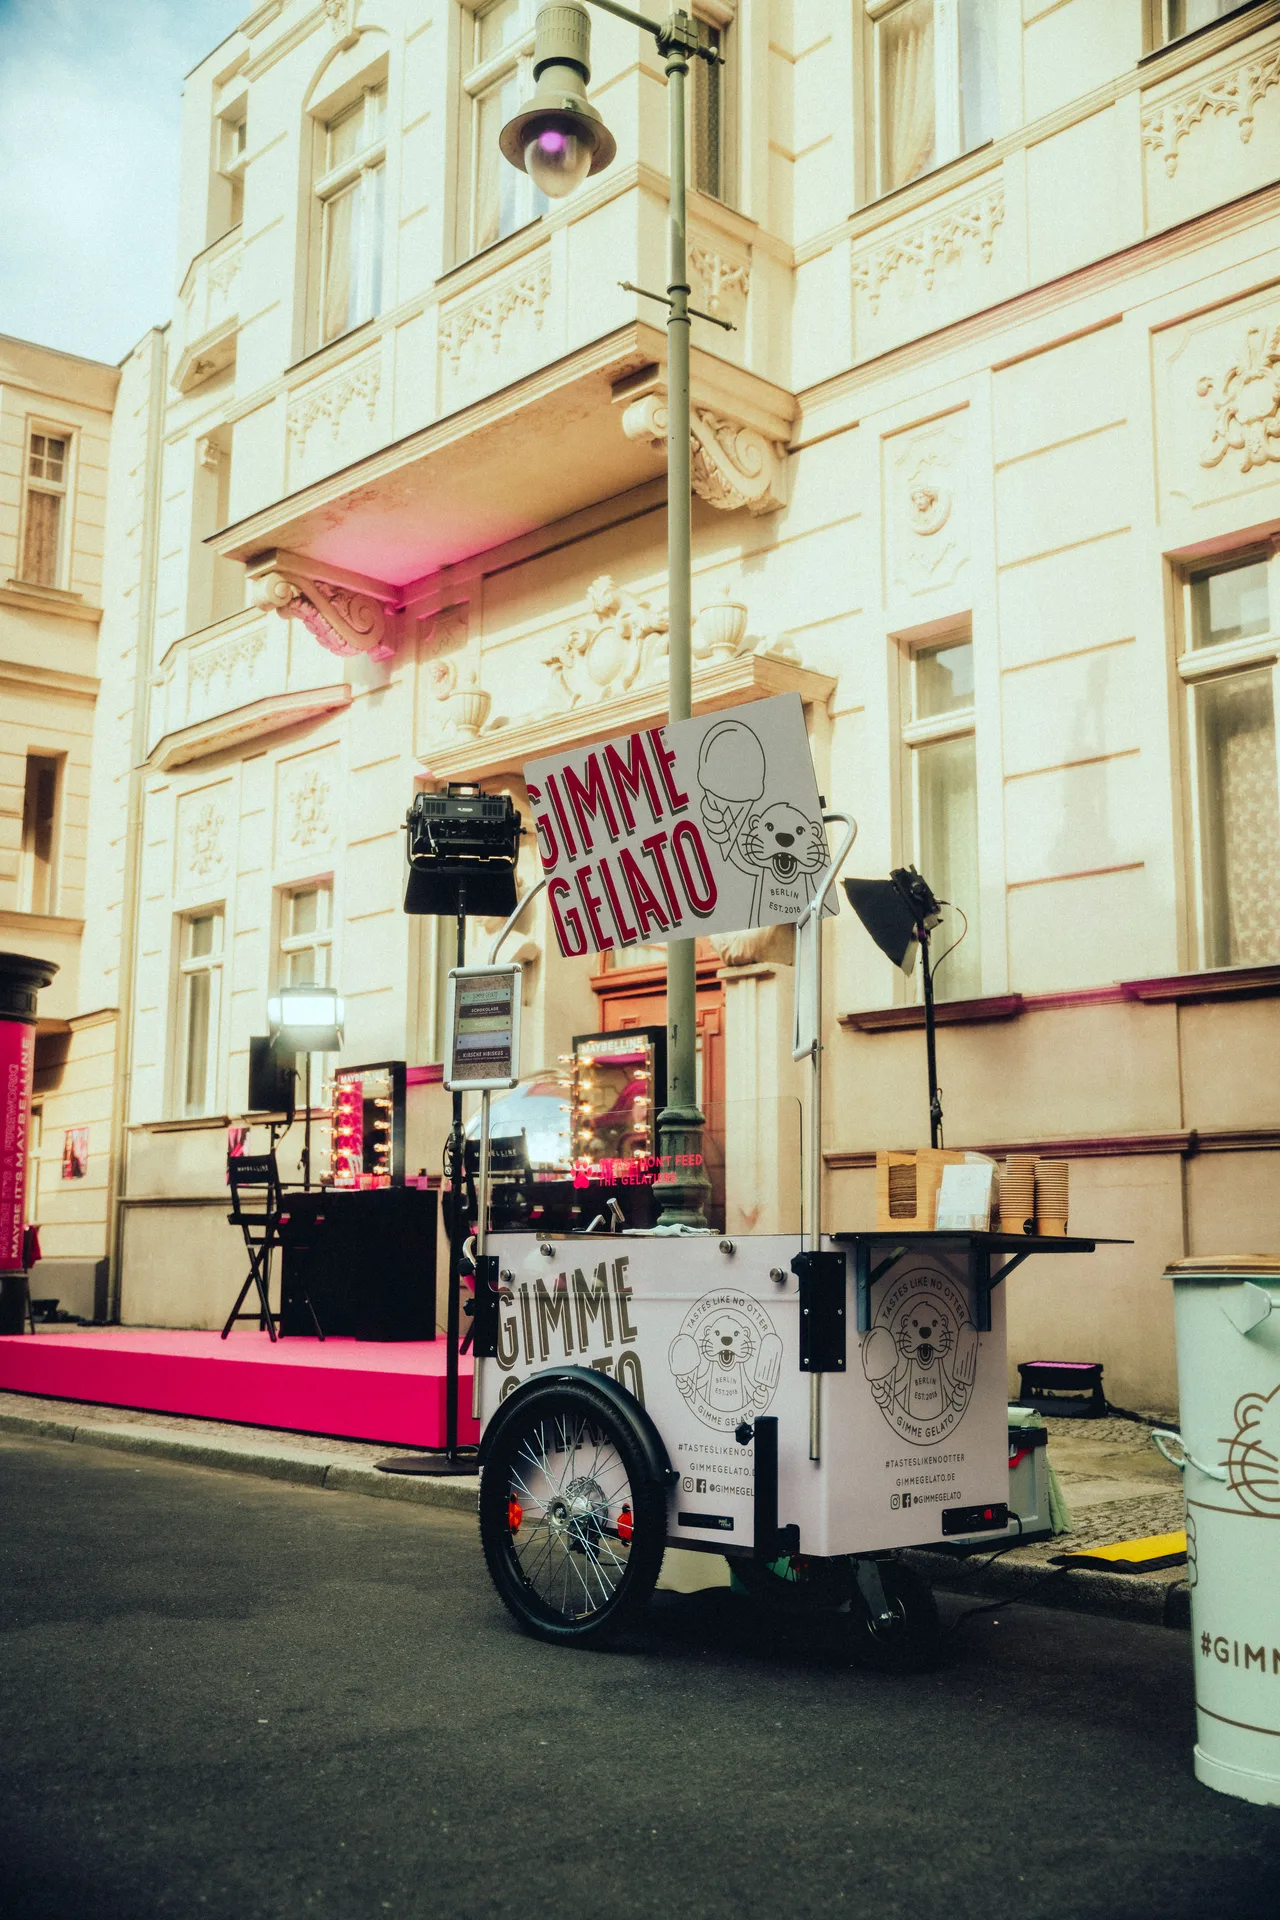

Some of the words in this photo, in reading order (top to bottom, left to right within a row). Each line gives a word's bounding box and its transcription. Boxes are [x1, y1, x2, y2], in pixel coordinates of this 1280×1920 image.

[528, 726, 690, 874] GIMME
[547, 820, 718, 957] GELATO
[770, 888, 799, 899] BERLIN
[769, 901, 801, 914] EST.2018
[582, 1037, 643, 1053] MAYBELLINE
[16, 1037, 29, 1167] MAYBELLINE
[638, 1155, 672, 1169] DON'T
[675, 1153, 703, 1167] FEED
[14, 1172, 22, 1199] IT'S
[599, 1175, 618, 1187] THE
[621, 1171, 677, 1186] GELATIERE
[11, 1204, 21, 1258] MAYBE
[882, 1283, 909, 1319] TASTES
[909, 1276, 928, 1289] LIKE
[930, 1278, 942, 1291] NO
[944, 1287, 965, 1319] OTTER
[496, 1256, 638, 1371] GIMME
[687, 1301, 711, 1329] TASTES
[712, 1295, 730, 1306] LIKE
[732, 1296, 745, 1307] NO
[747, 1304, 769, 1332] OTTER
[715, 1376, 737, 1385] BERLIN
[914, 1377, 936, 1386] BERLIN
[698, 1405, 722, 1426] GIMME
[725, 1409, 754, 1426] GELATO
[897, 1416, 922, 1438] GIMME
[925, 1414, 954, 1437] GELATO
[886, 1454, 965, 1468] #TASTESLIKENOOTTER
[896, 1473, 955, 1486] GIMMEGELATO.DE
[913, 1491, 962, 1504] @GIMMEGELATO
